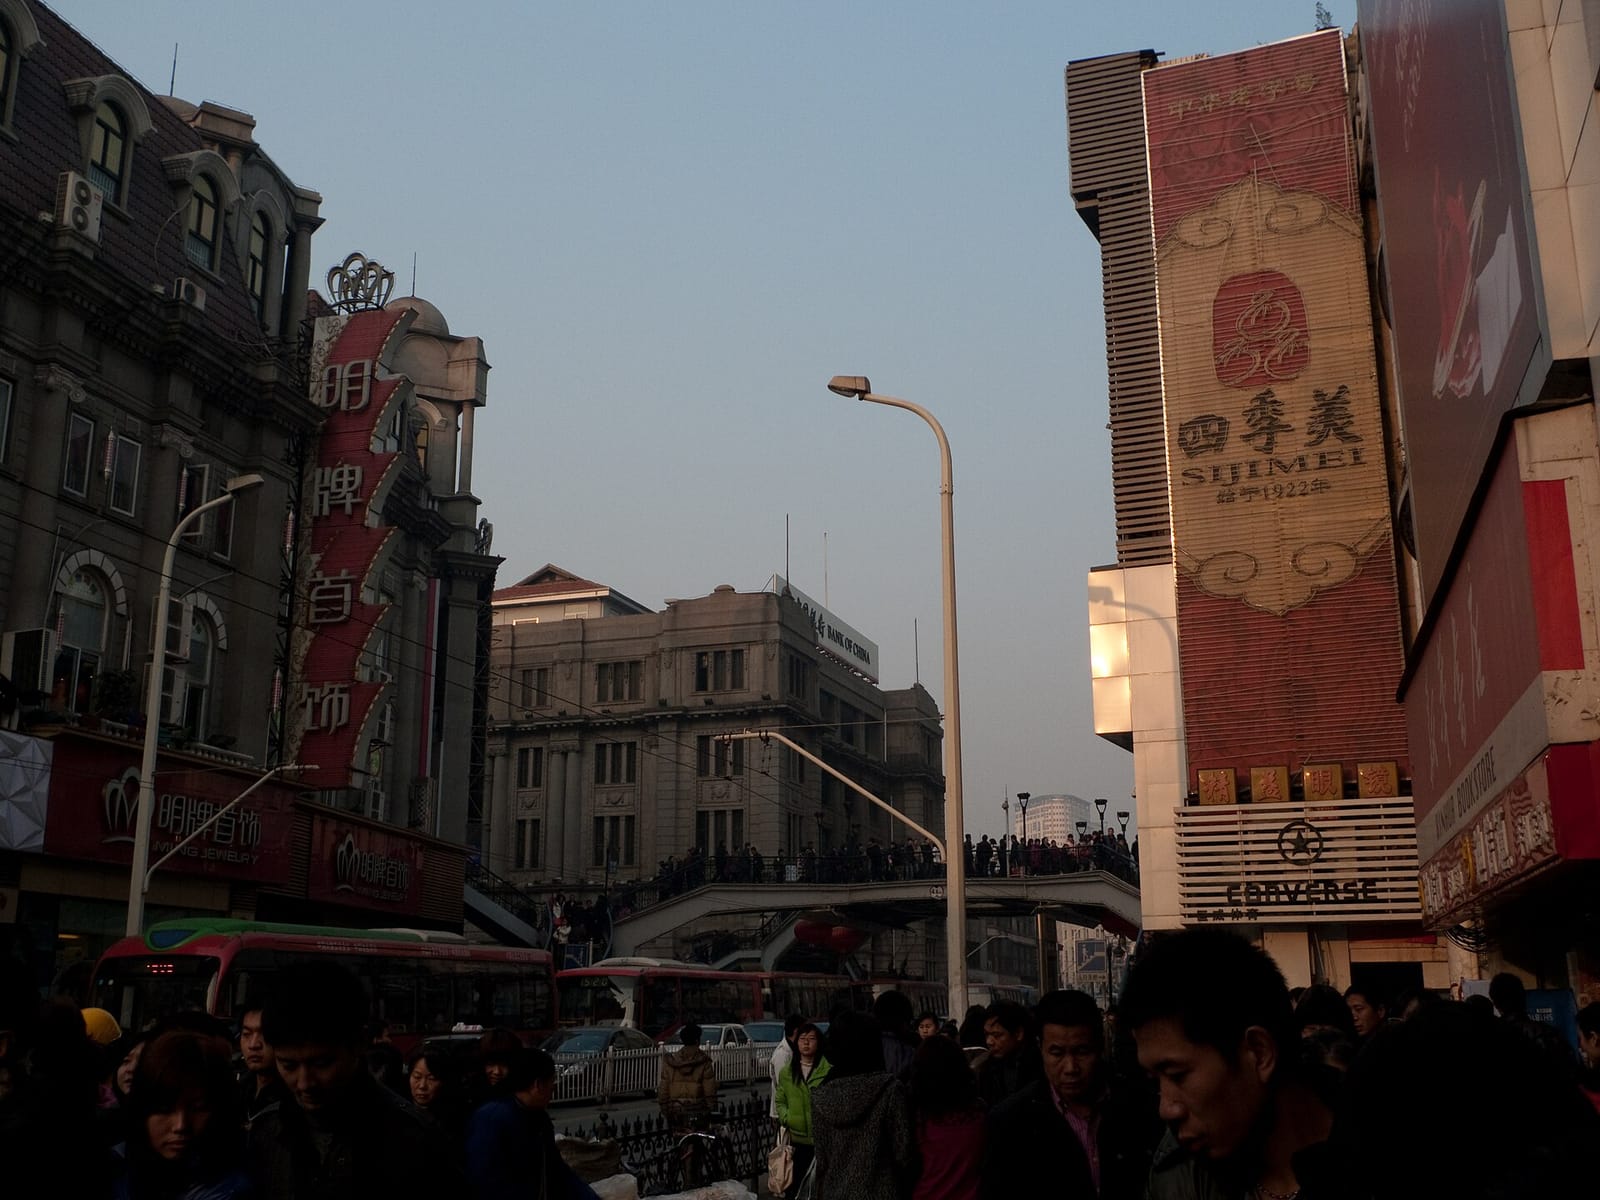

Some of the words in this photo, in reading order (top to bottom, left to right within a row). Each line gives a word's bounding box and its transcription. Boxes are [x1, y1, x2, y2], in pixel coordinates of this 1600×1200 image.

[1178, 384, 1364, 458] 四季美
[1182, 447, 1367, 486] SIJIMEI
[301, 358, 372, 735] 明牌首饰
[827, 623, 845, 648] BANK
[845, 637, 853, 654] OF
[853, 642, 871, 664] CHINA
[158, 793, 261, 849] 明牌首饰
[200, 847, 259, 864] JEWELRY
[1226, 880, 1378, 905] CONVERSE
